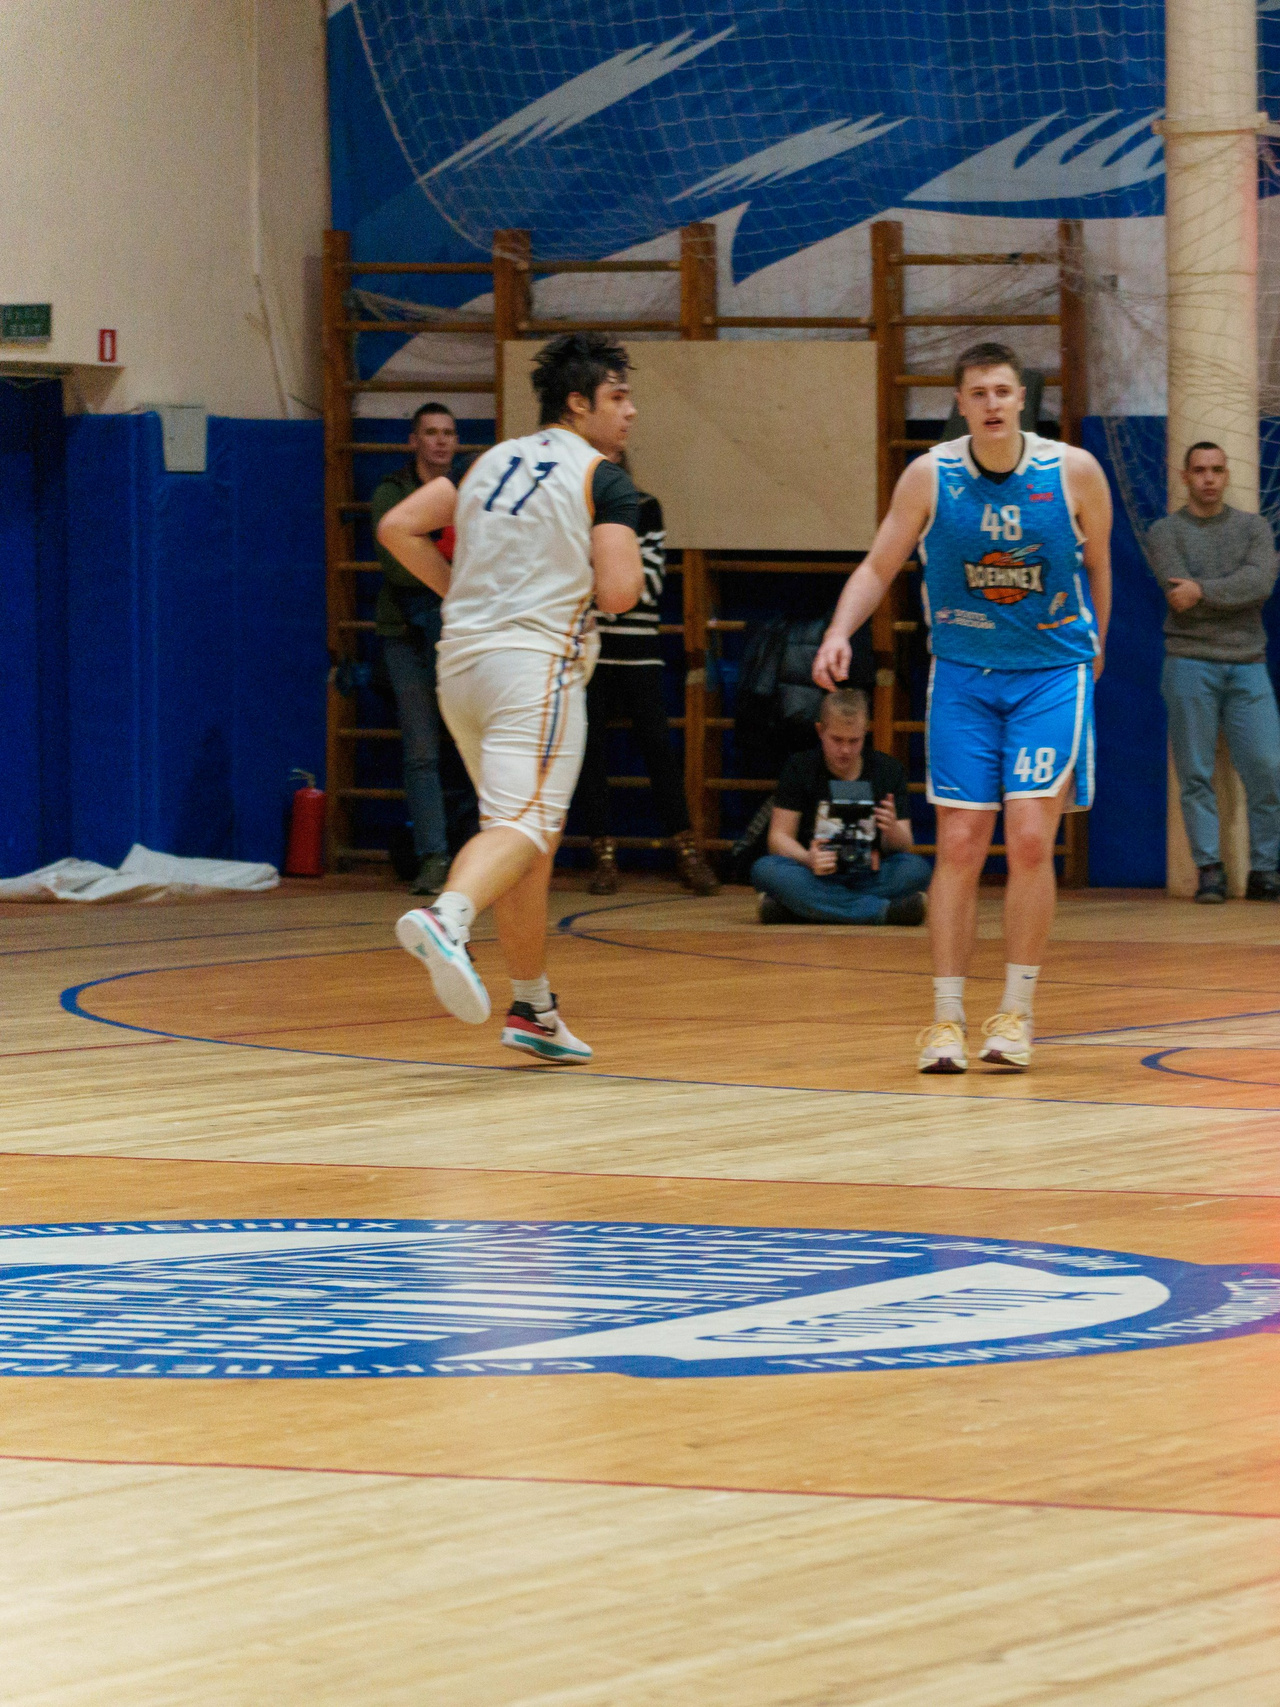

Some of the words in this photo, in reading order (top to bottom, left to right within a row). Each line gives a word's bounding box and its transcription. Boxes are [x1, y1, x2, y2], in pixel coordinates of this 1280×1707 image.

[484, 456, 558, 516] 17
[980, 503, 1023, 541] 48
[1013, 746, 1057, 783] 48
[429, 1223, 875, 1240] ТЕХНОЛОГИЙ
[0, 1361, 597, 1374] САНКТ-ПЕТЕР
[767, 1336, 1138, 1369] ТРАДИЦИИ
